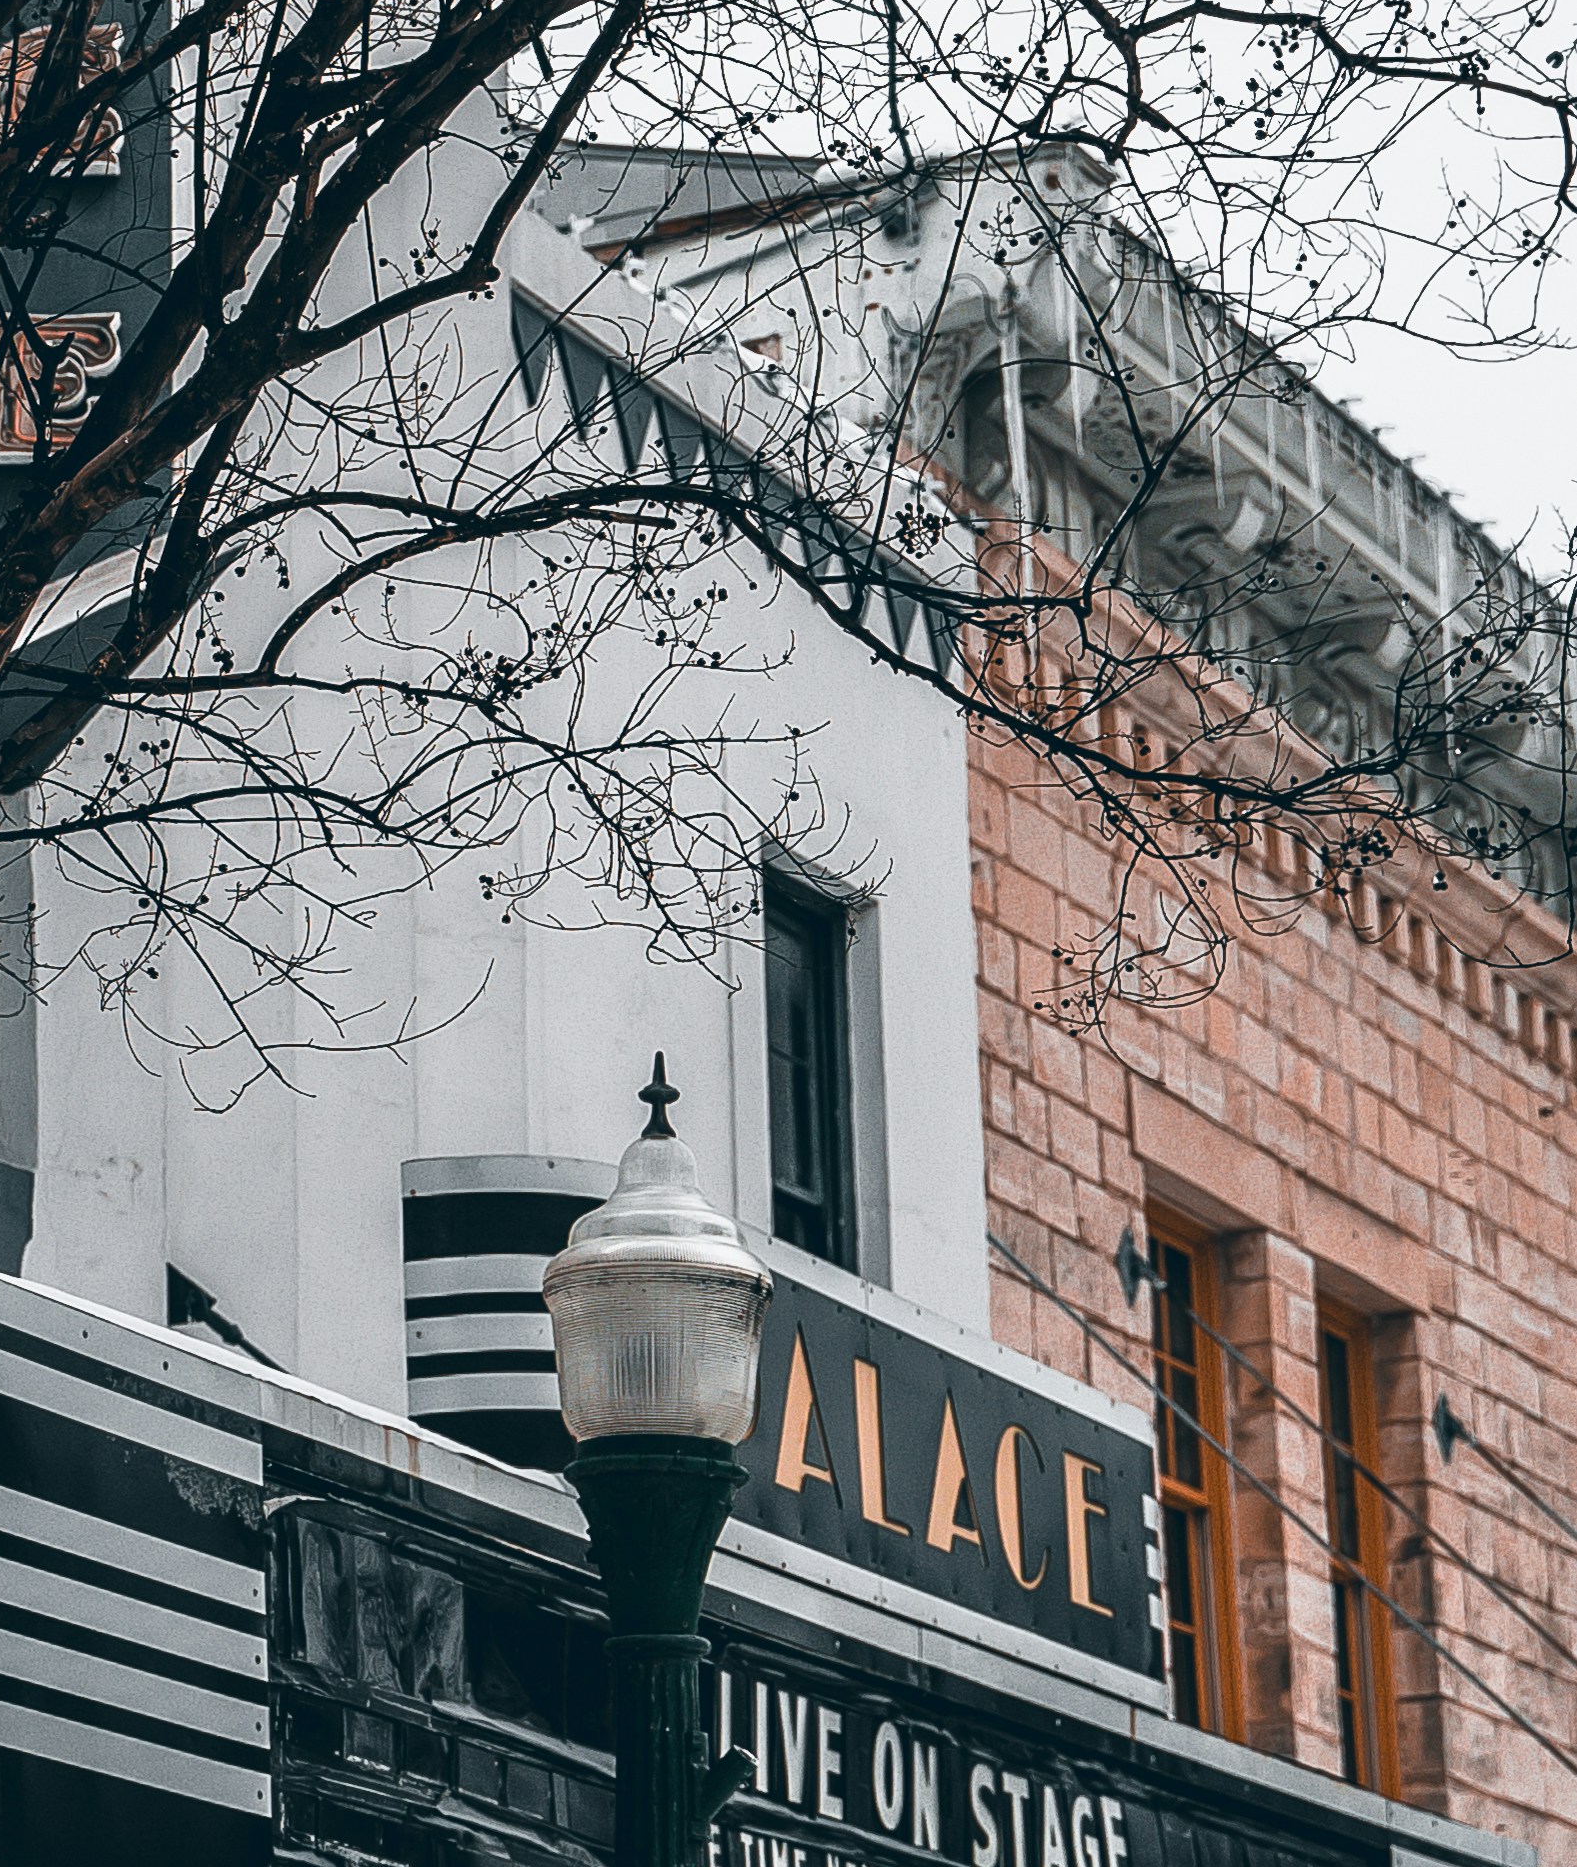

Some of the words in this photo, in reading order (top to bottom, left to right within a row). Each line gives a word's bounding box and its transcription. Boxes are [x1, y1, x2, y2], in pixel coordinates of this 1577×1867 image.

[754, 1320, 1116, 1619] ALACE
[719, 1670, 844, 1821] LIVE
[873, 1720, 940, 1852] ON
